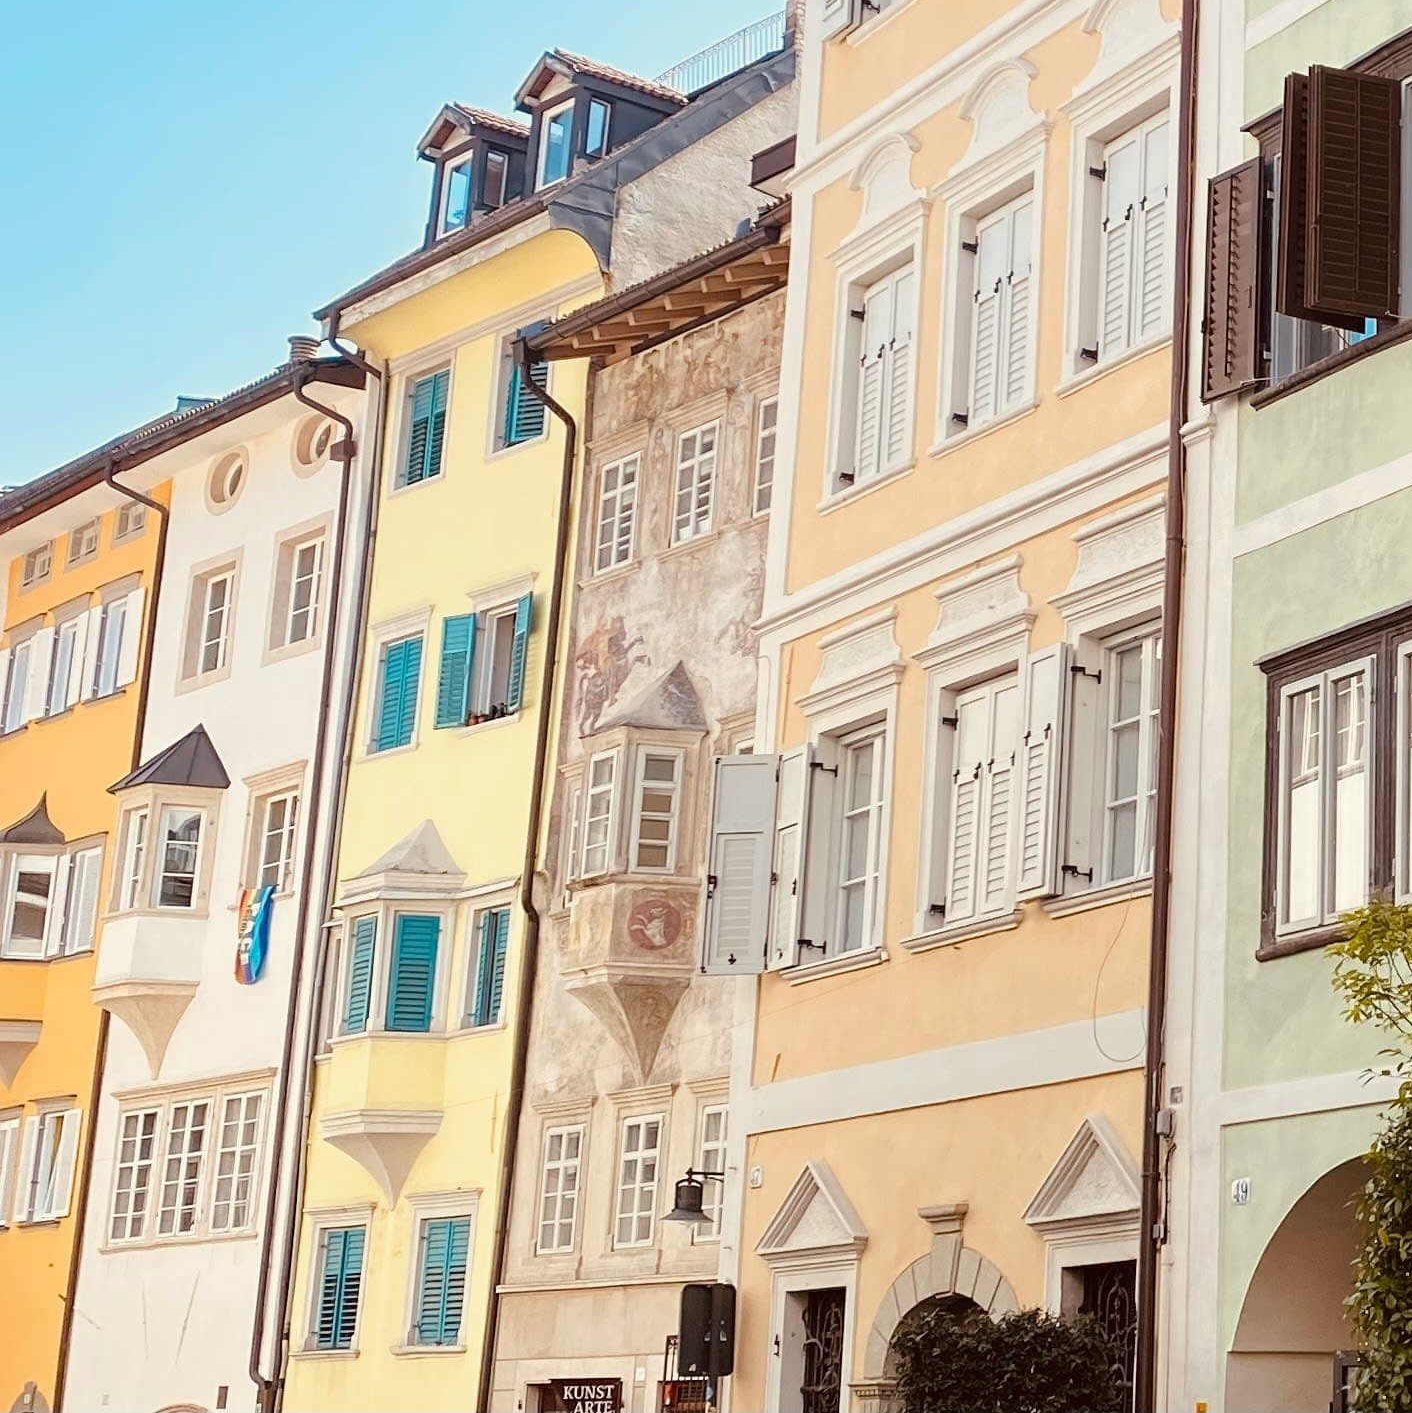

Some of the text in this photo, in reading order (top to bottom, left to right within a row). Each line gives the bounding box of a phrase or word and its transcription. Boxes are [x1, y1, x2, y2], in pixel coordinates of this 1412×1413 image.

[1232, 1179, 1249, 1203] 49
[563, 1385, 615, 1400] KUNST
[574, 1400, 613, 1413] ARTE
